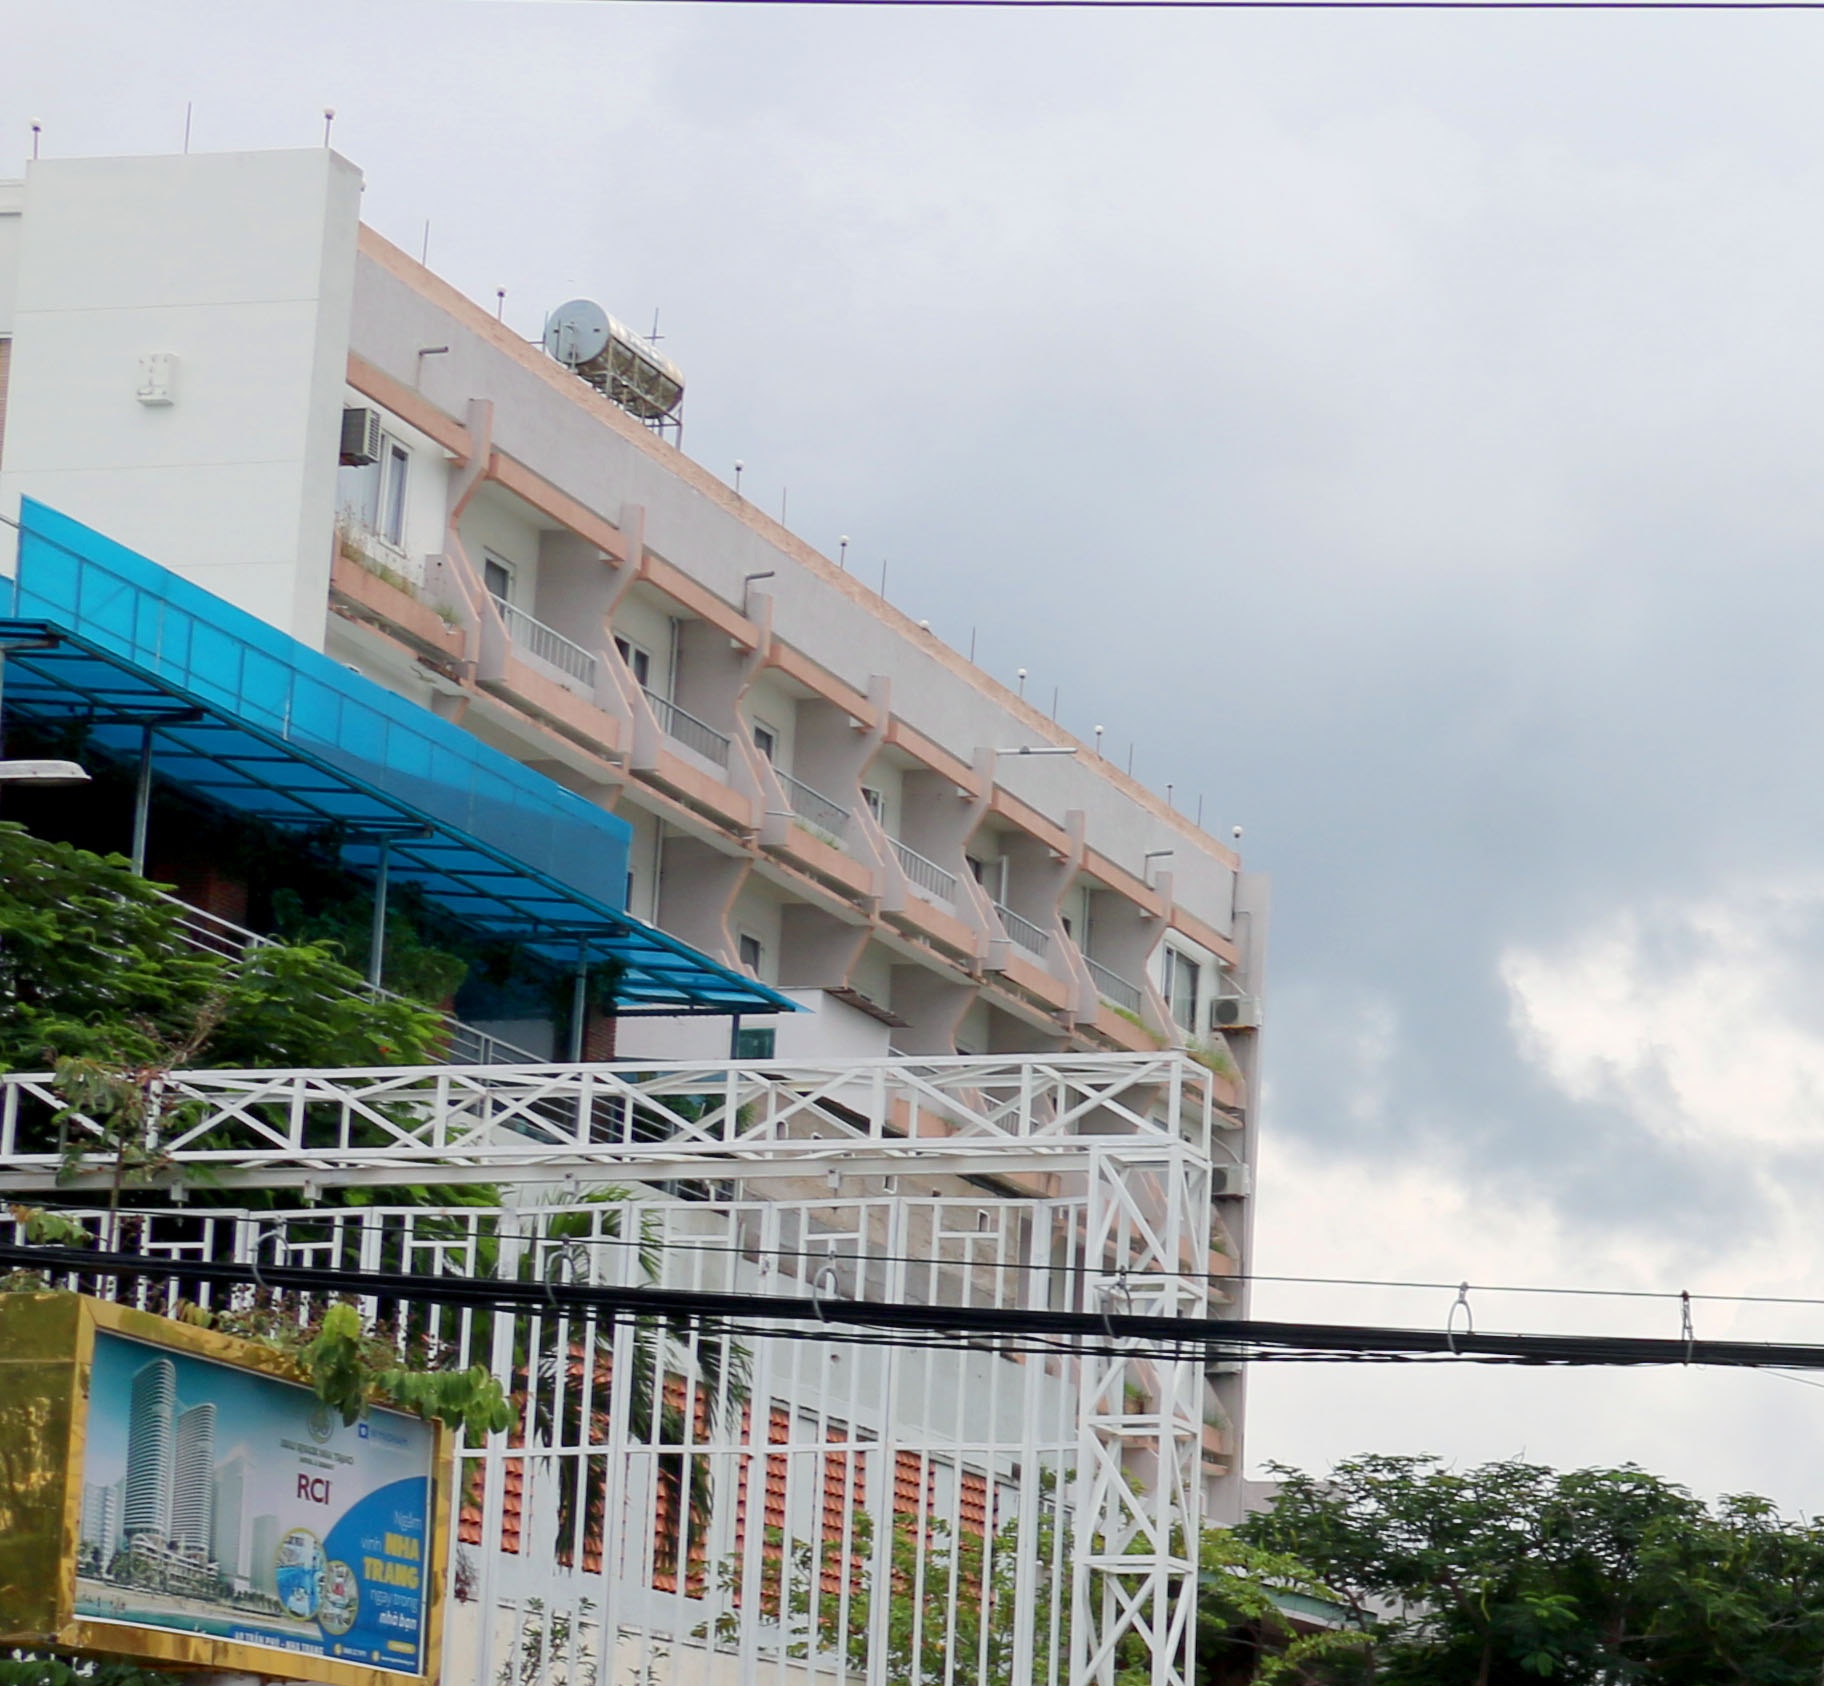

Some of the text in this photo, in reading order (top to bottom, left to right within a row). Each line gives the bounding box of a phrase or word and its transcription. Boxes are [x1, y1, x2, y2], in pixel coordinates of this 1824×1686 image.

[296, 1473, 330, 1505] RCI
[384, 1532, 420, 1561] NHA
[363, 1556, 419, 1590] TRANG
